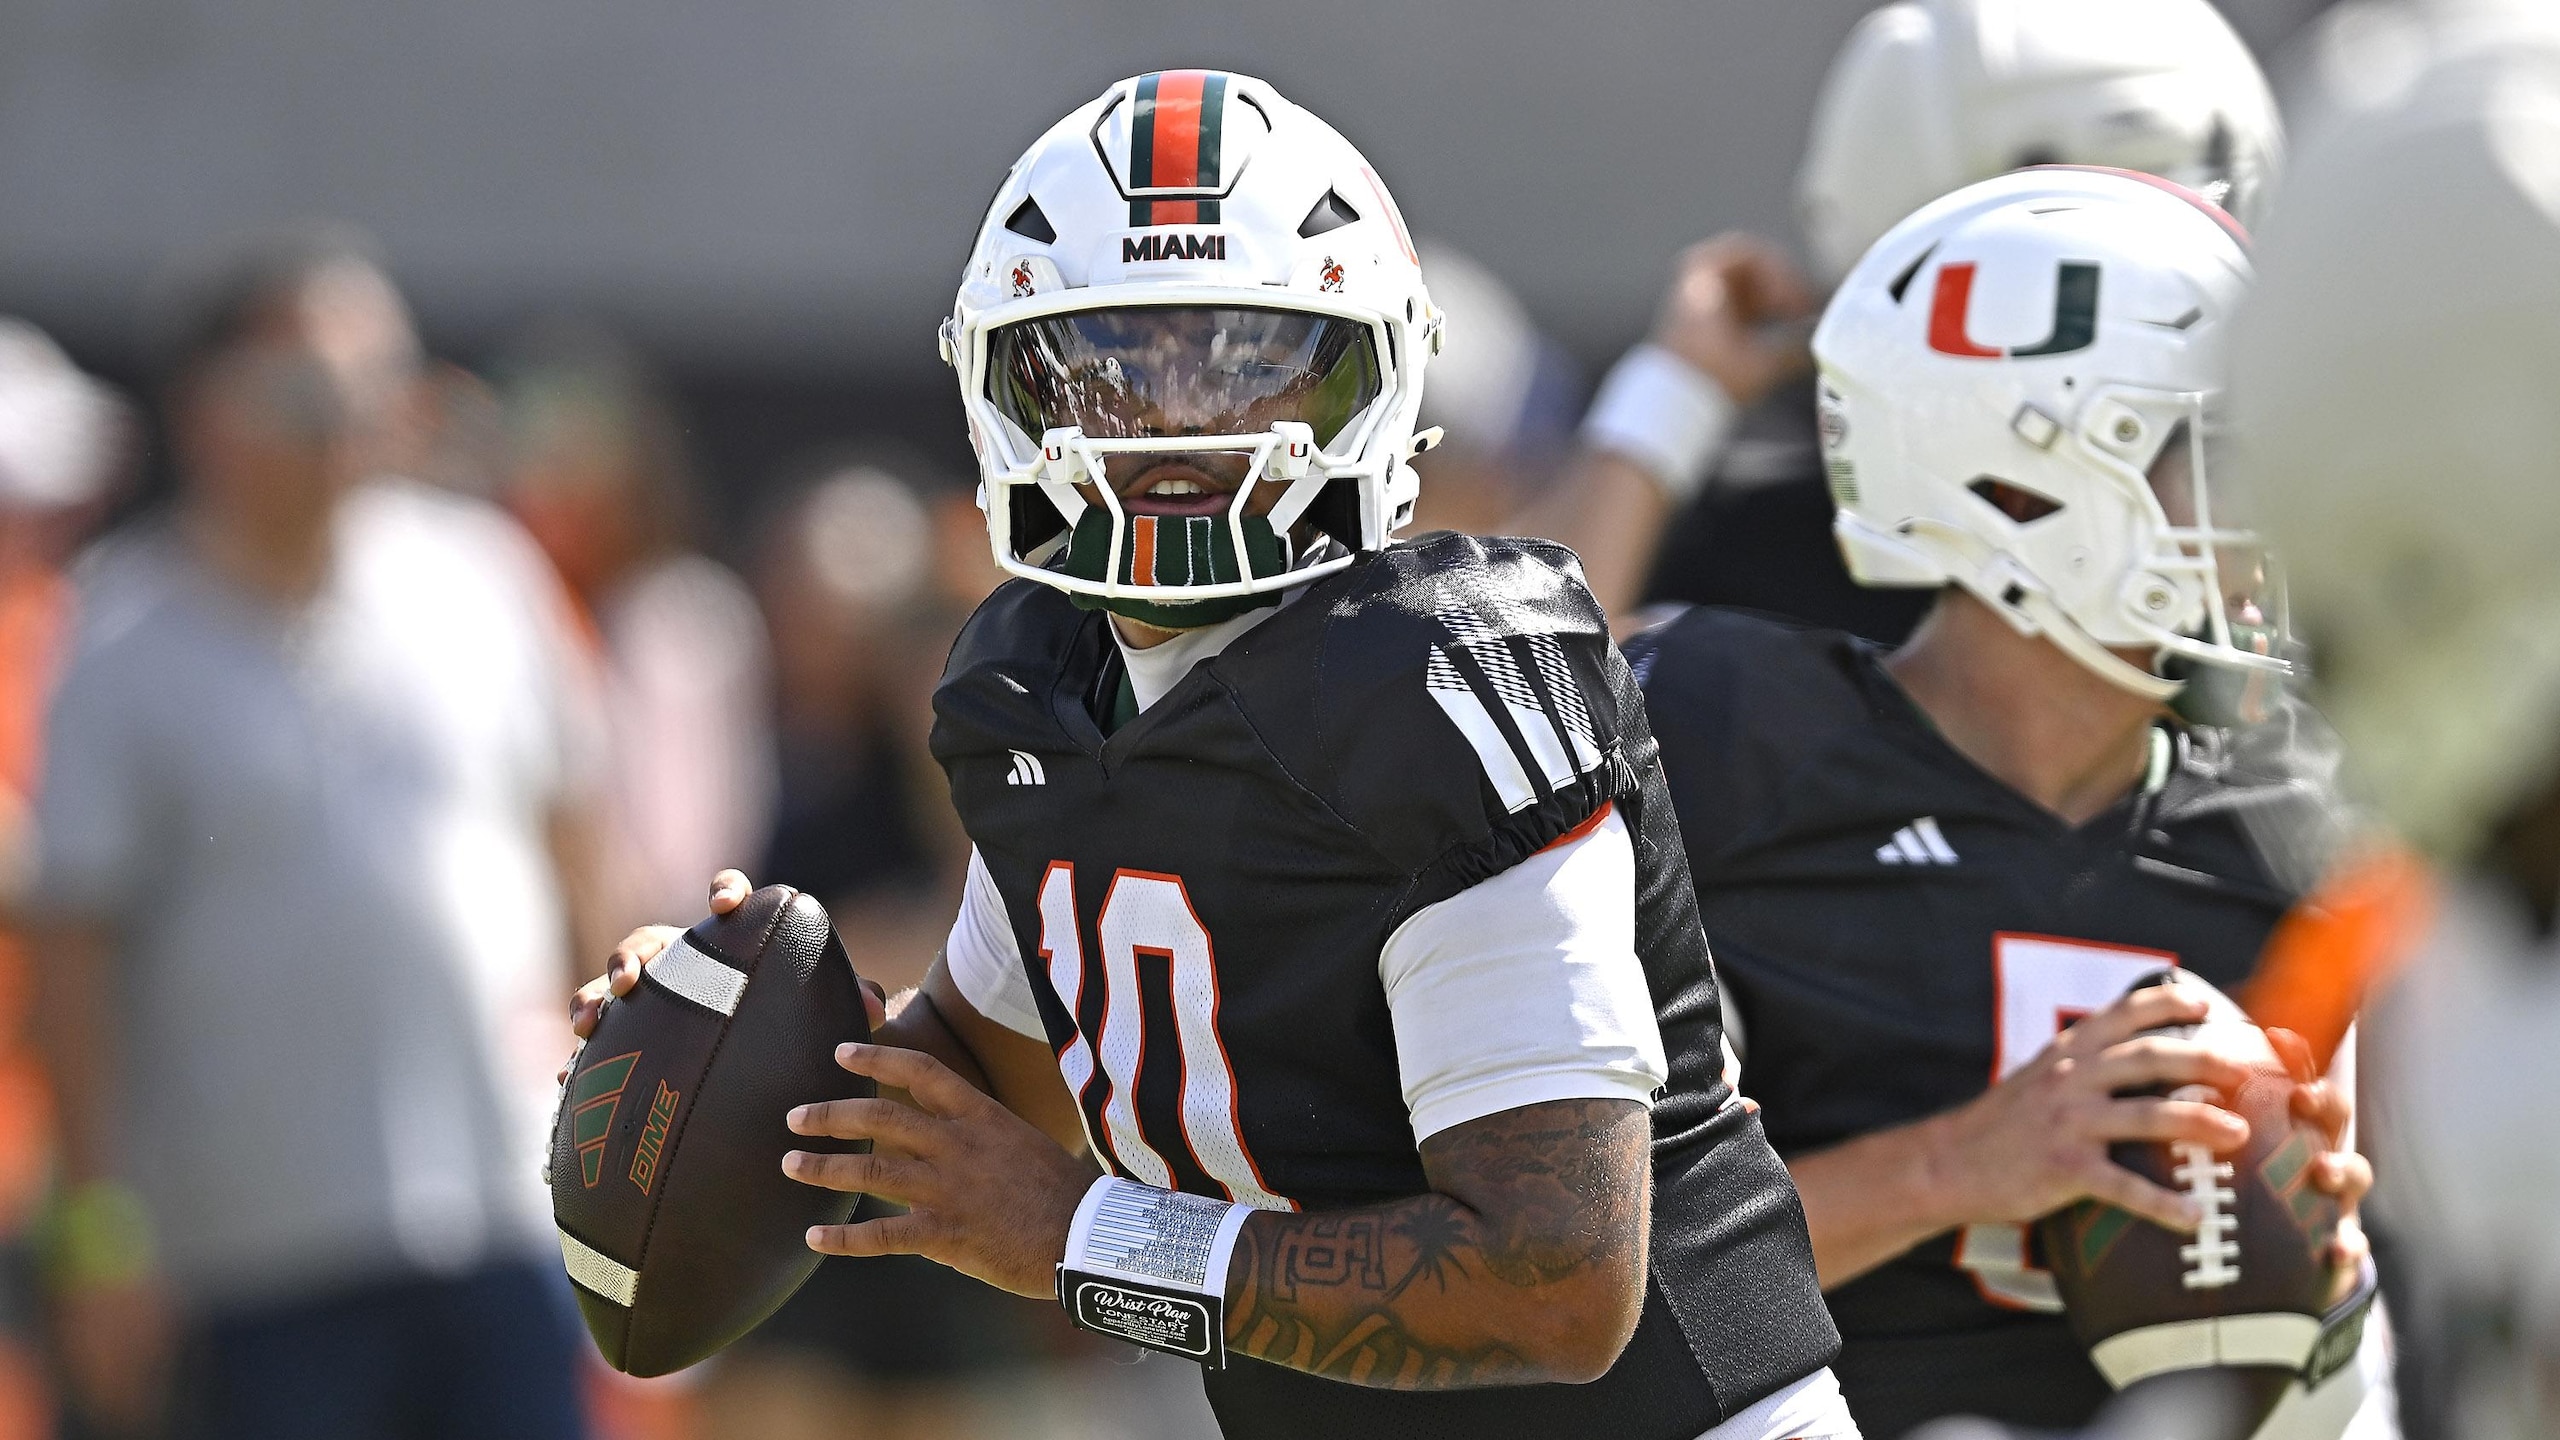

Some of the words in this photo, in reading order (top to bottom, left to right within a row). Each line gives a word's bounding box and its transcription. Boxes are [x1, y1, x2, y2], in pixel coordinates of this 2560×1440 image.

[1122, 235, 1226, 263] MIAMI
[1927, 259, 2102, 361] U
[1045, 446, 1062, 461] U
[1290, 443, 1308, 457] U
[1037, 860, 1302, 1212] 10
[629, 1078, 680, 1197] DIME
[1094, 1291, 1146, 1312] Wrist
[1147, 1301, 1191, 1321] Plan
